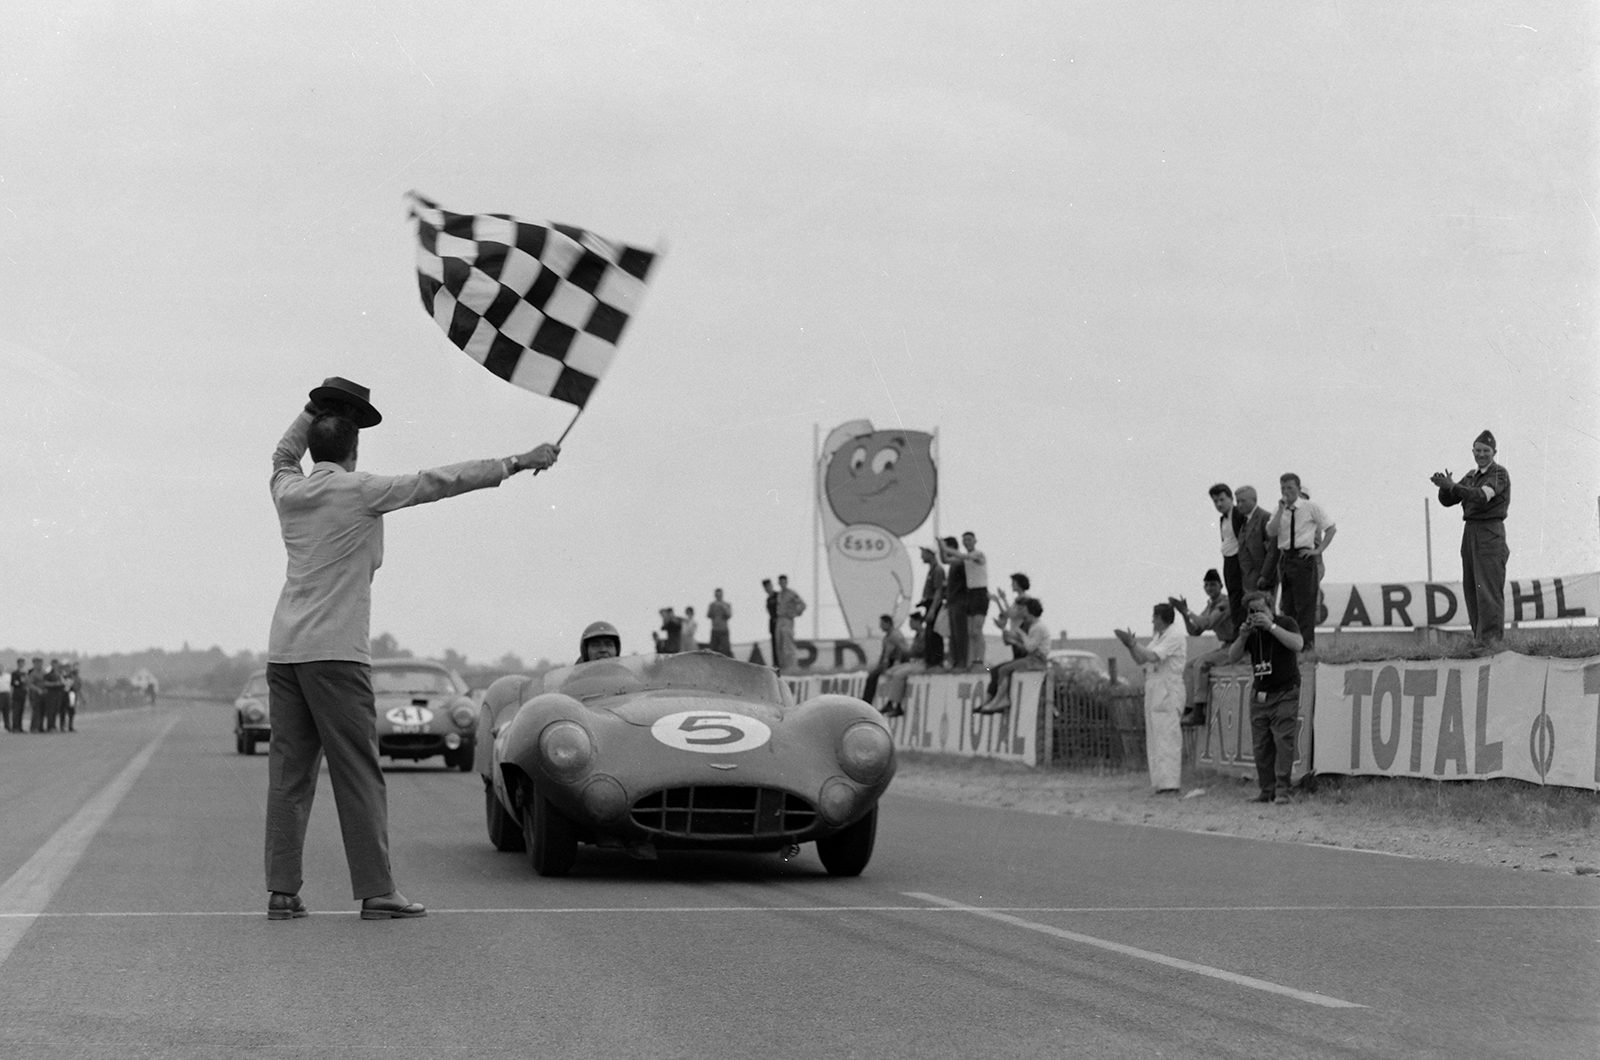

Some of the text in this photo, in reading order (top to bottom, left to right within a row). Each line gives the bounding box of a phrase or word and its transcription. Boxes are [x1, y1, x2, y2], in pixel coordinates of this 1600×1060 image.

[1318, 578, 1586, 627] ARDHL
[678, 715, 745, 746] 5
[1343, 664, 1503, 775] TOTAL
